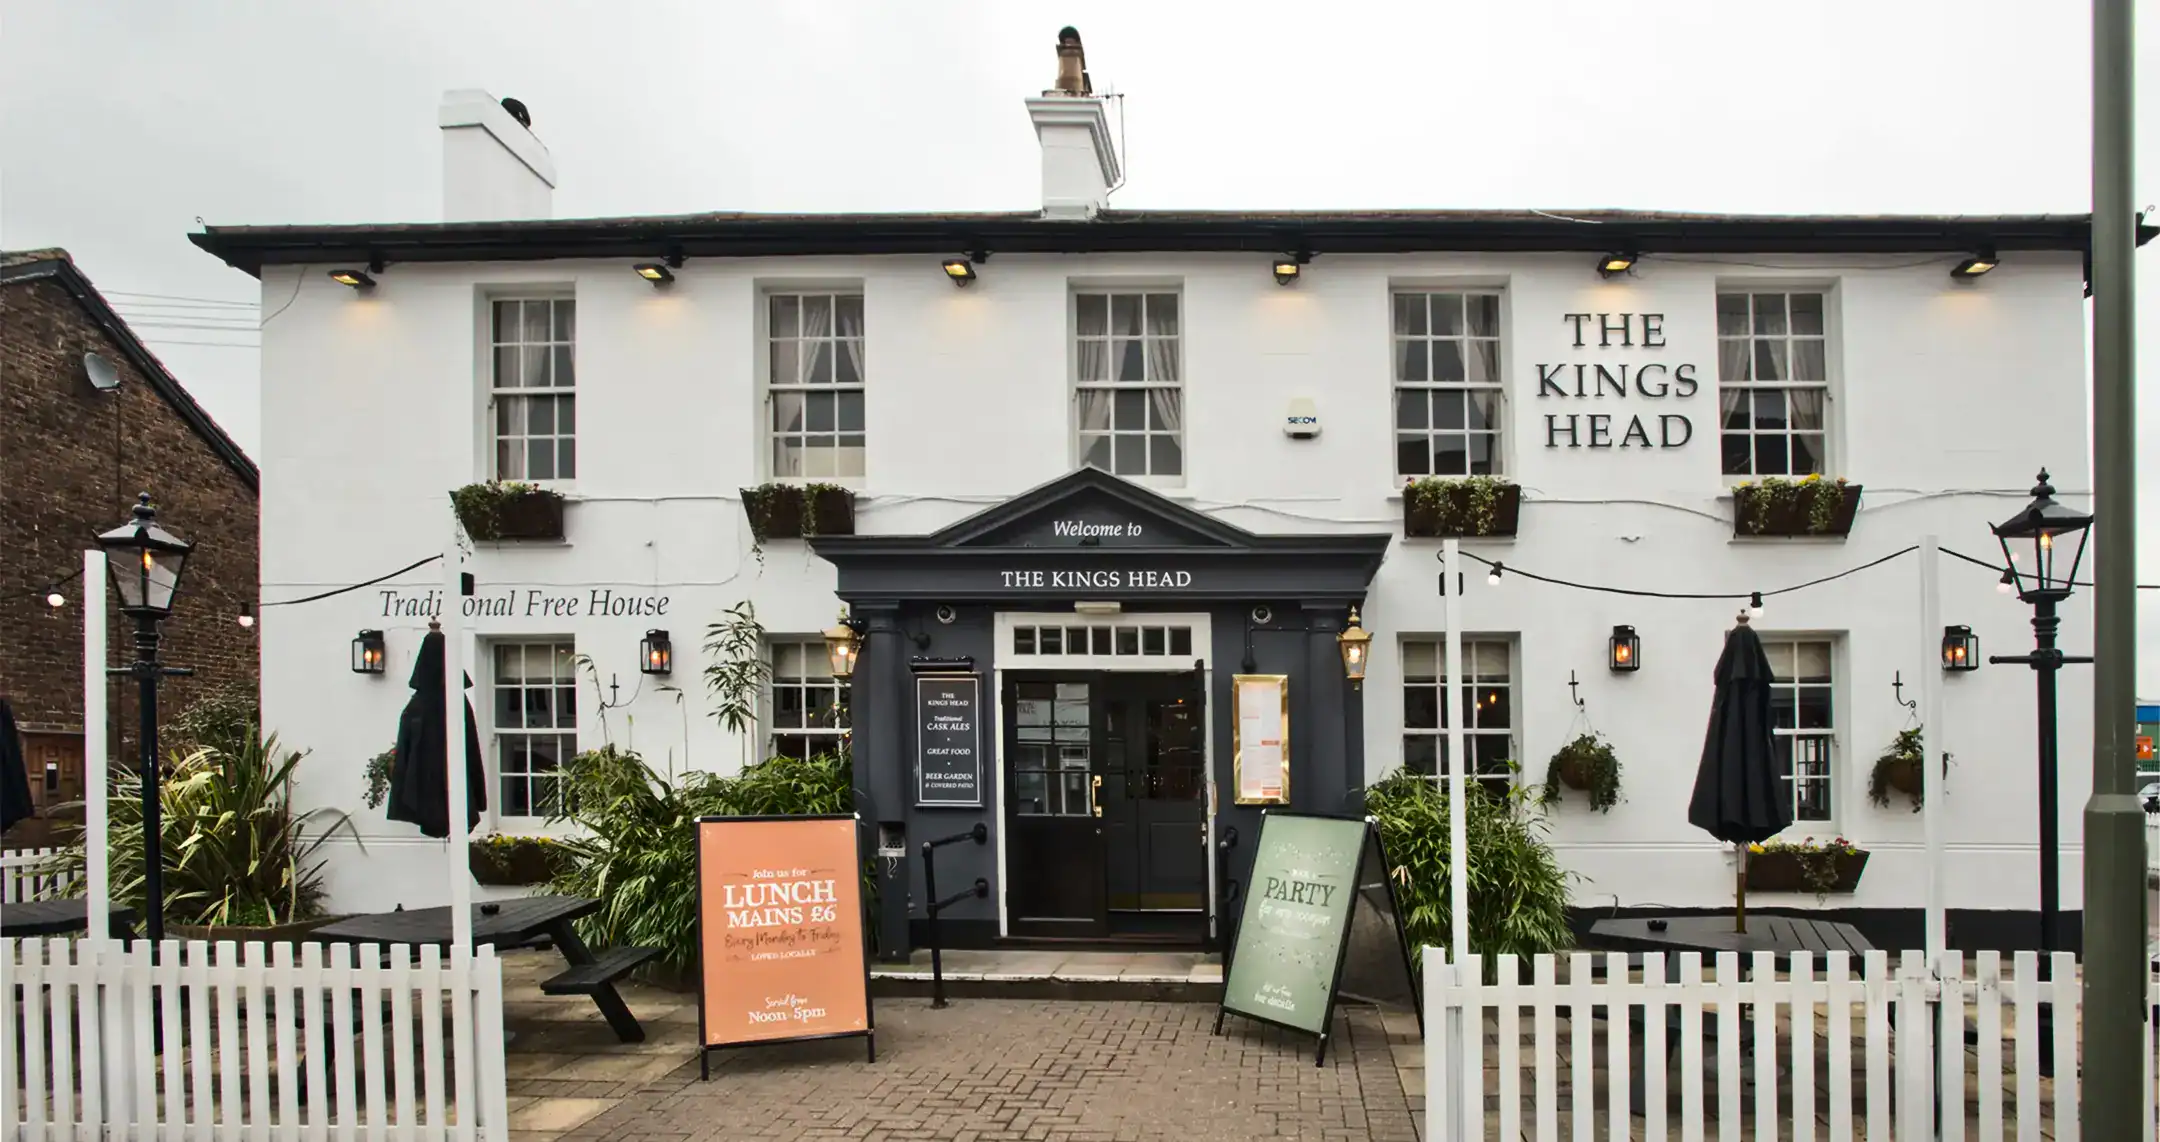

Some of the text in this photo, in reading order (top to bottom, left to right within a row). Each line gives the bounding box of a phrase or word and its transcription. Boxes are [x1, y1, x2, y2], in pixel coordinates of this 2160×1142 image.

[1563, 313, 1667, 347] THE
[1534, 363, 1699, 398] KINGS
[1544, 414, 1693, 448] HEAD
[1053, 520, 1142, 537] Welcome to
[1001, 571, 1192, 587] THE KINGS HEAD
[379, 589, 670, 617] Tradional Free House
[926, 722, 970, 731] CASK ALES
[926, 747, 950, 755] GREAT
[925, 772, 973, 780] BEER GARDEN
[752, 867, 808, 879] Join us for
[723, 879, 838, 909] LUNCH
[1264, 876, 1337, 907] PARTY
[727, 904, 838, 928] MAINS £6
[724, 926, 841, 951] Every Monday to Friday
[748, 1006, 826, 1025] Noon 5pm
